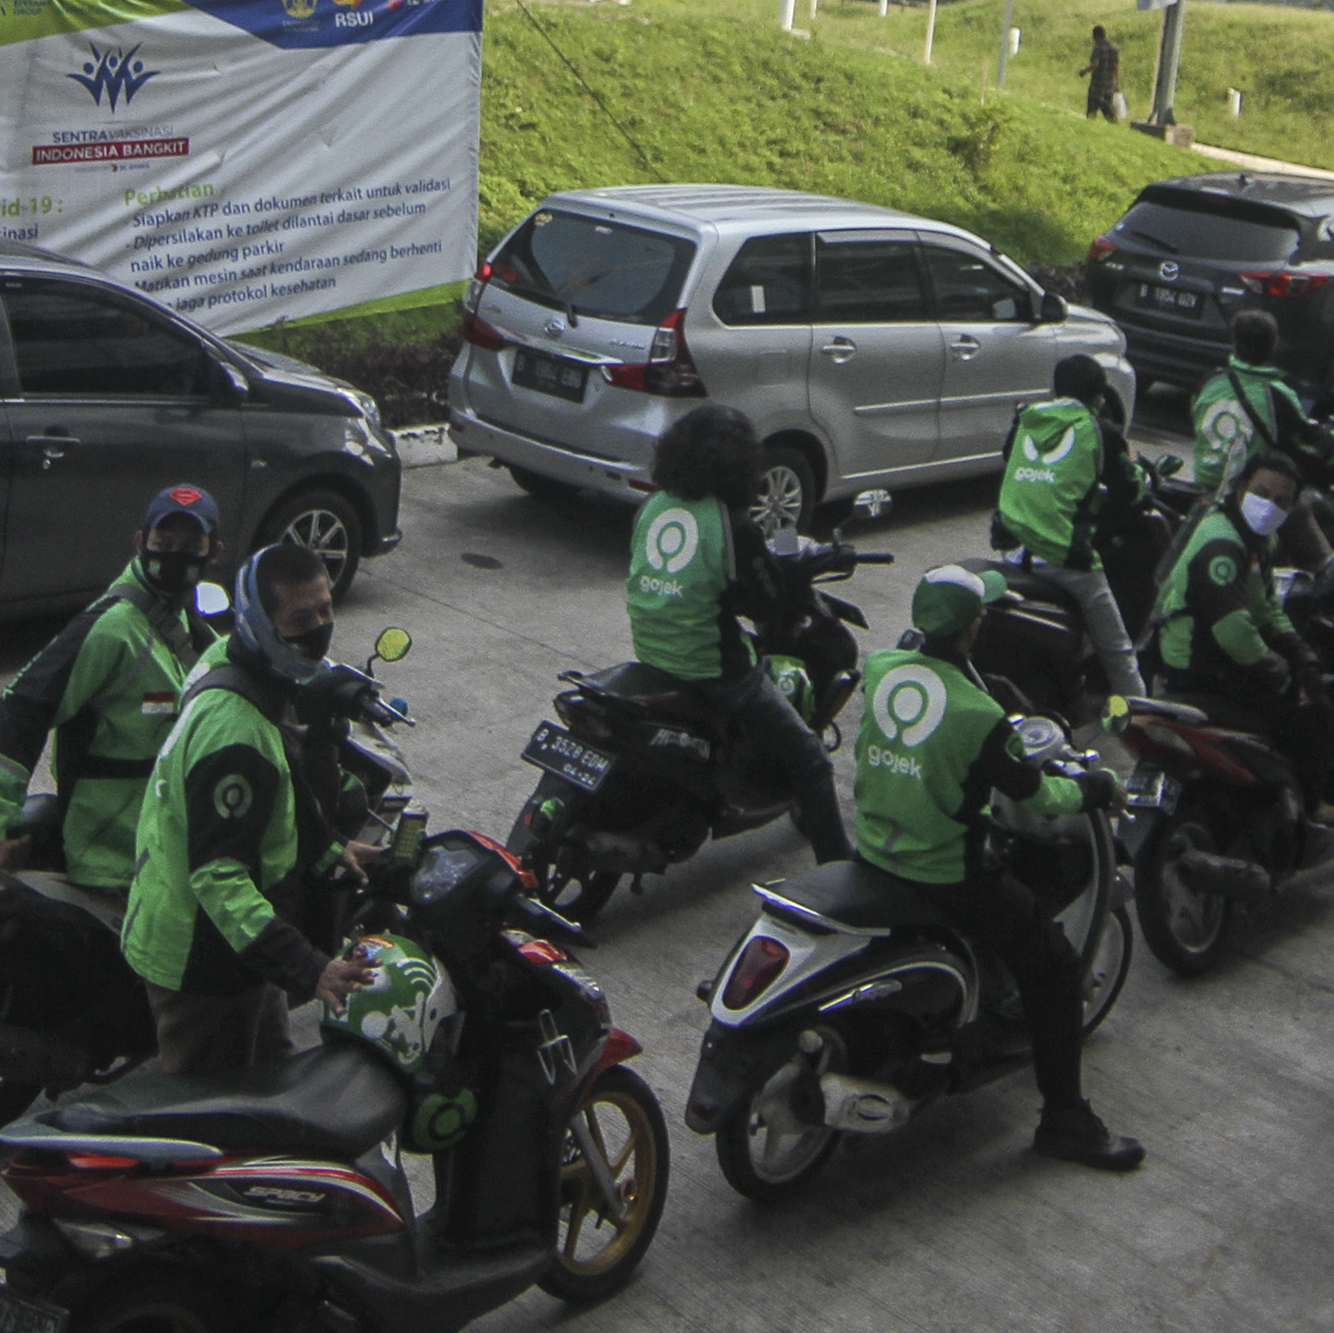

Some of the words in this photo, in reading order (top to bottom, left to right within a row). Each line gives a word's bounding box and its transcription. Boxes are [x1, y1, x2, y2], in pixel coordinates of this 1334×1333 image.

[335, 11, 373, 27] RSUI
[36, 145, 119, 162] INDONESIA
[123, 141, 186, 156] BANGKIT
[133, 210, 190, 228] Siapkan
[192, 203, 219, 219] KTP
[222, 202, 251, 216] dan
[254, 196, 317, 213] dokumen
[320, 187, 363, 204] terkait
[366, 182, 402, 199] untuk
[405, 177, 451, 194] validasi
[134, 229, 223, 251] Dipersilakan
[227, 224, 244, 238] ke
[247, 219, 280, 235] toilet
[283, 213, 334, 231] dilantai
[338, 210, 371, 225] dasar
[373, 202, 426, 220] sebelum
[131, 255, 163, 273] naik
[167, 254, 184, 269] ke
[188, 247, 238, 266] gedung
[242, 240, 285, 259] parkir
[194, 269, 237, 286] mesin
[241, 265, 267, 280] saat
[269, 256, 341, 276] kendaraan
[343, 250, 388, 265] sedang
[390, 240, 442, 259] berhenti
[208, 284, 268, 309] protokol
[270, 277, 336, 297] kesehatan
[1015, 467, 1055, 483] gojek
[640, 575, 684, 598] gojek
[868, 745, 923, 780] gojek
